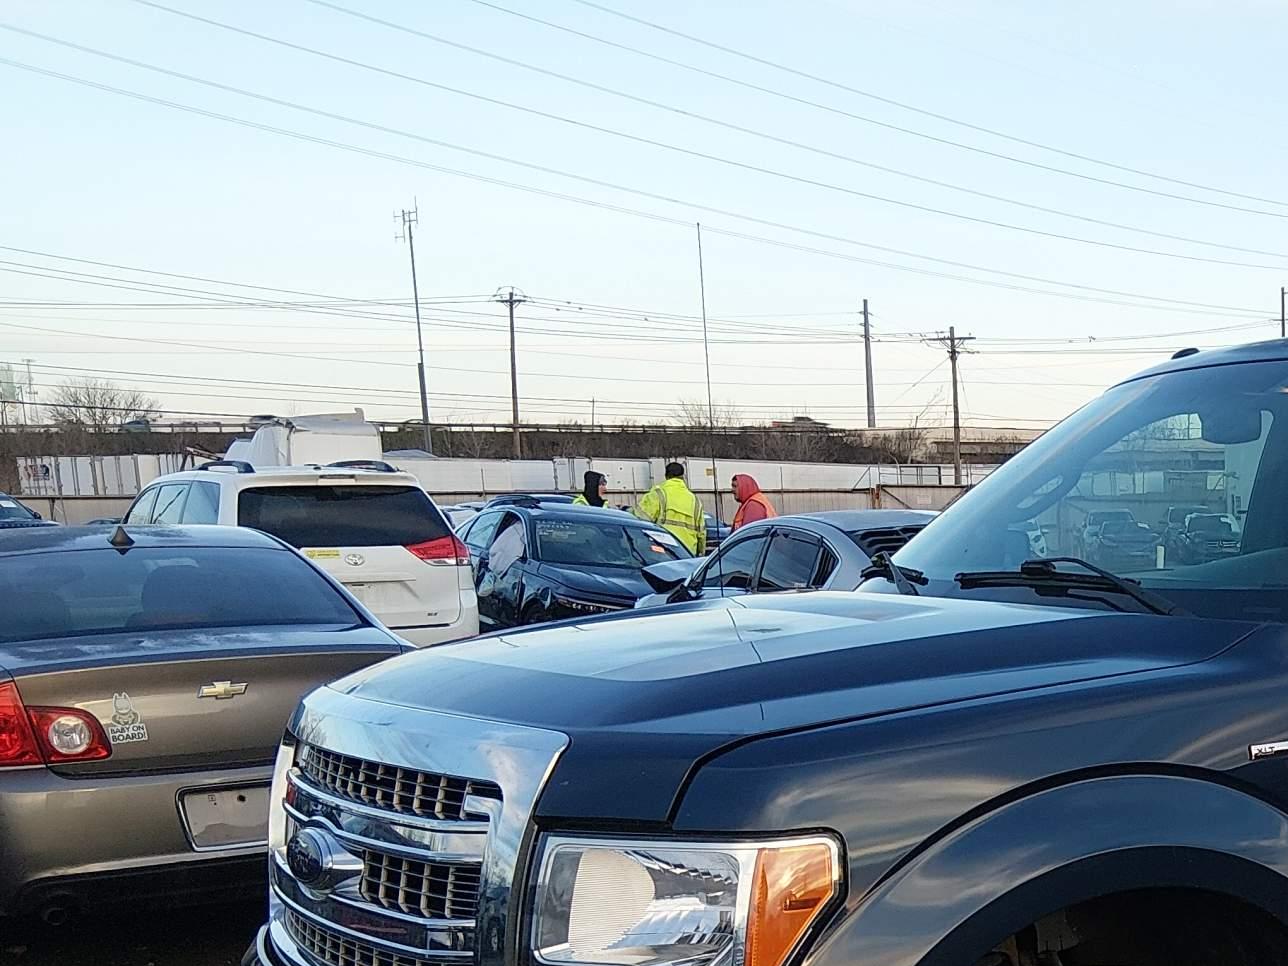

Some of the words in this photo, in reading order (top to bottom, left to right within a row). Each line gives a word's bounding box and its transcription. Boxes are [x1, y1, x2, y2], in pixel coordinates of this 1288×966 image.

[111, 726, 130, 734] BABY
[111, 731, 147, 742] BOARD!
[1256, 746, 1276, 756] XLT
